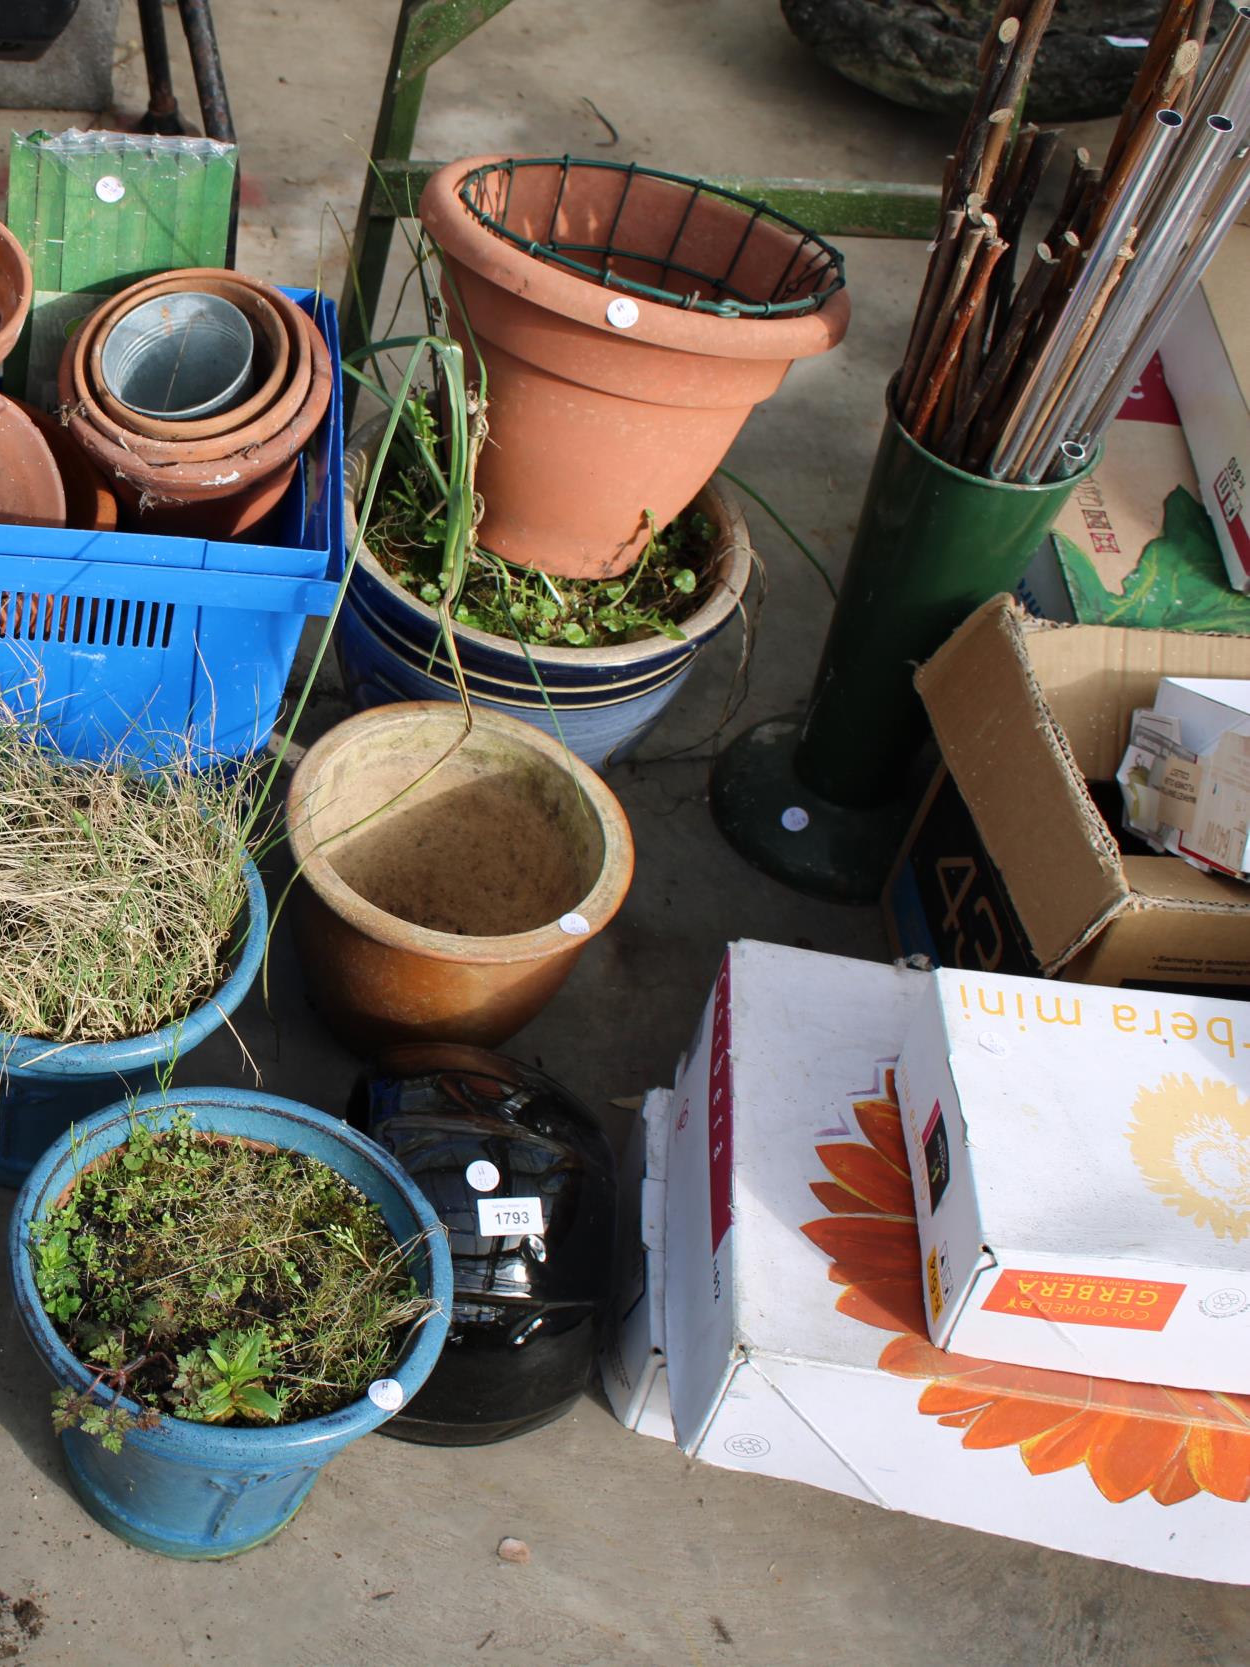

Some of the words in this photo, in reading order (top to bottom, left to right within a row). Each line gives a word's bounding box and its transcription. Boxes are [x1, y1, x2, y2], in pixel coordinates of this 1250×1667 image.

[960, 984, 1081, 1032] mini
[495, 1211, 530, 1225] 1793
[1017, 1279, 1159, 1306] GERBERA
[1003, 1296, 1035, 1310] BY
[1038, 1301, 1150, 1321] COLOURED
